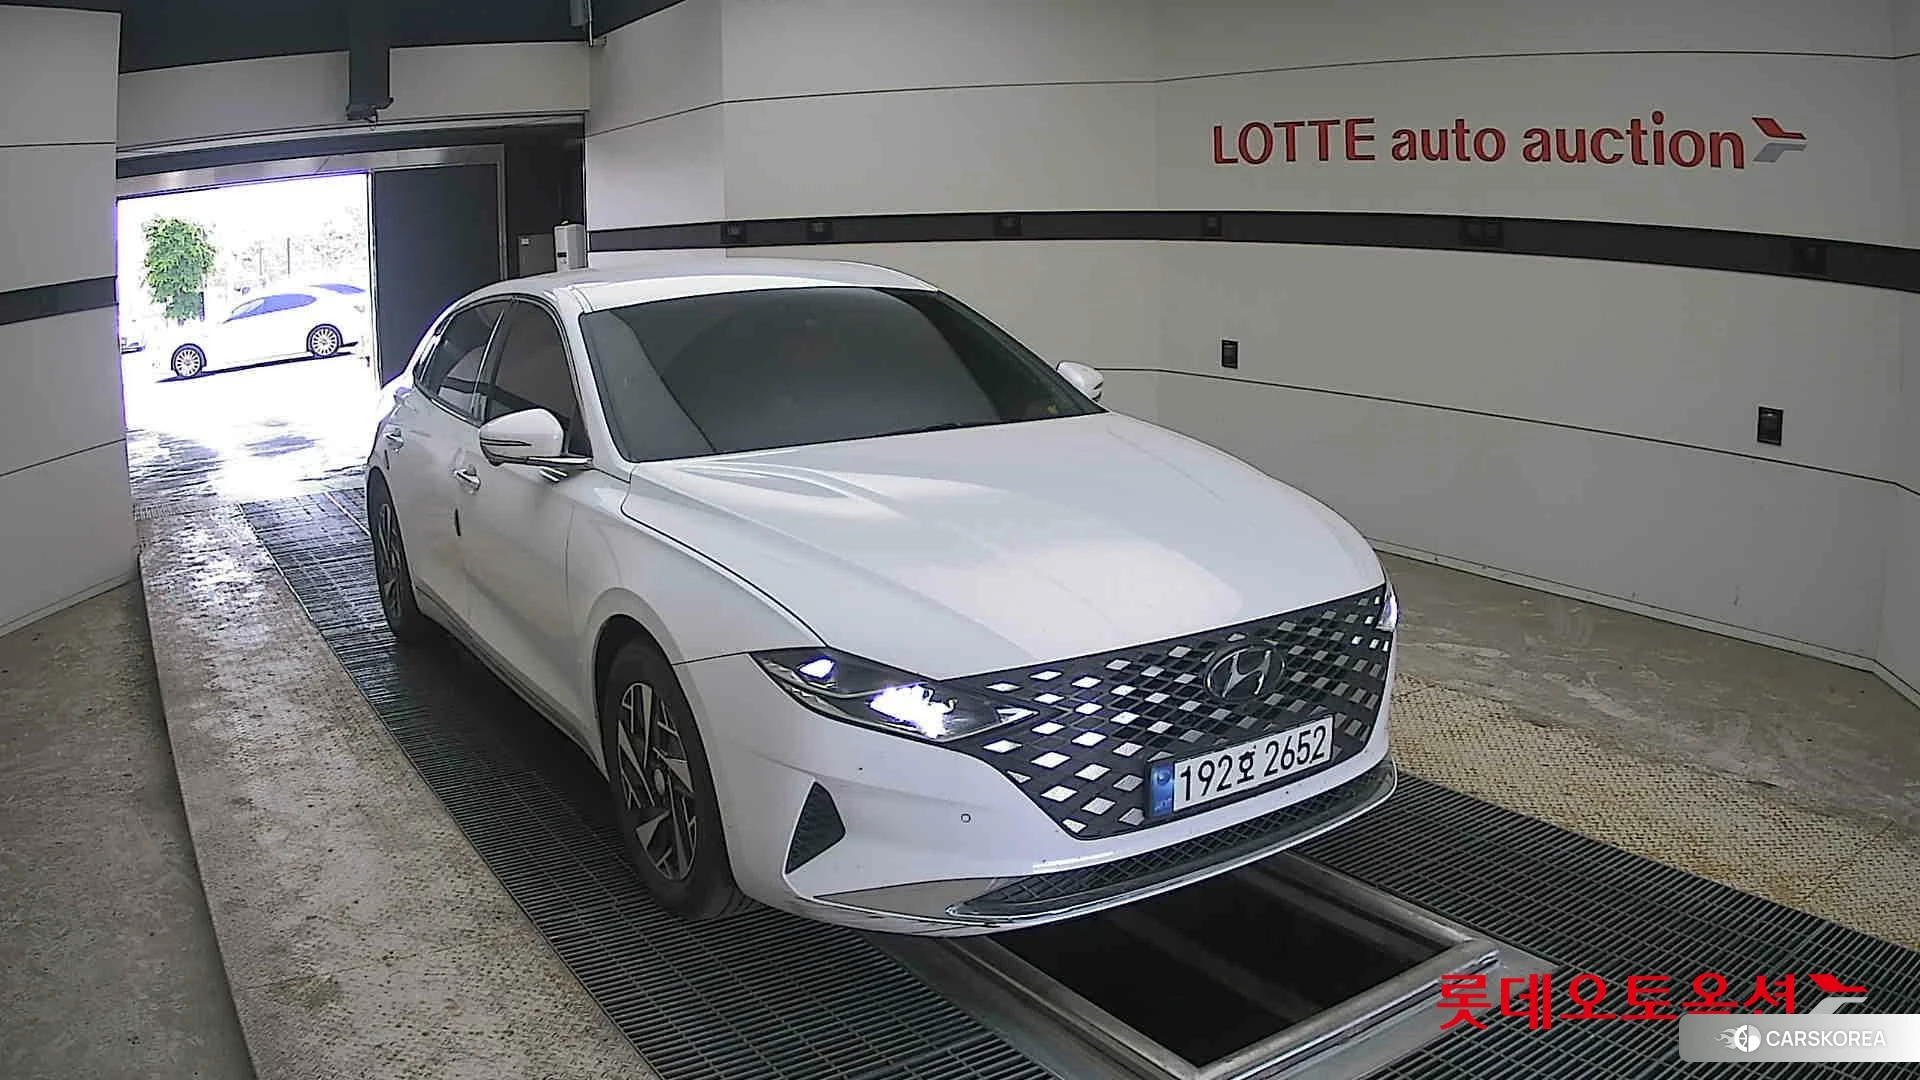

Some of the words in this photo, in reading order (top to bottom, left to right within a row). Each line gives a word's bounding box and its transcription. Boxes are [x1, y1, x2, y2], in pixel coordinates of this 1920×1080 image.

[1213, 117, 1376, 164] LOTTE
[1391, 117, 1506, 162] auto
[1522, 110, 1746, 170] auction
[1180, 746, 1255, 802] 192호
[1263, 725, 1327, 778] 2652
